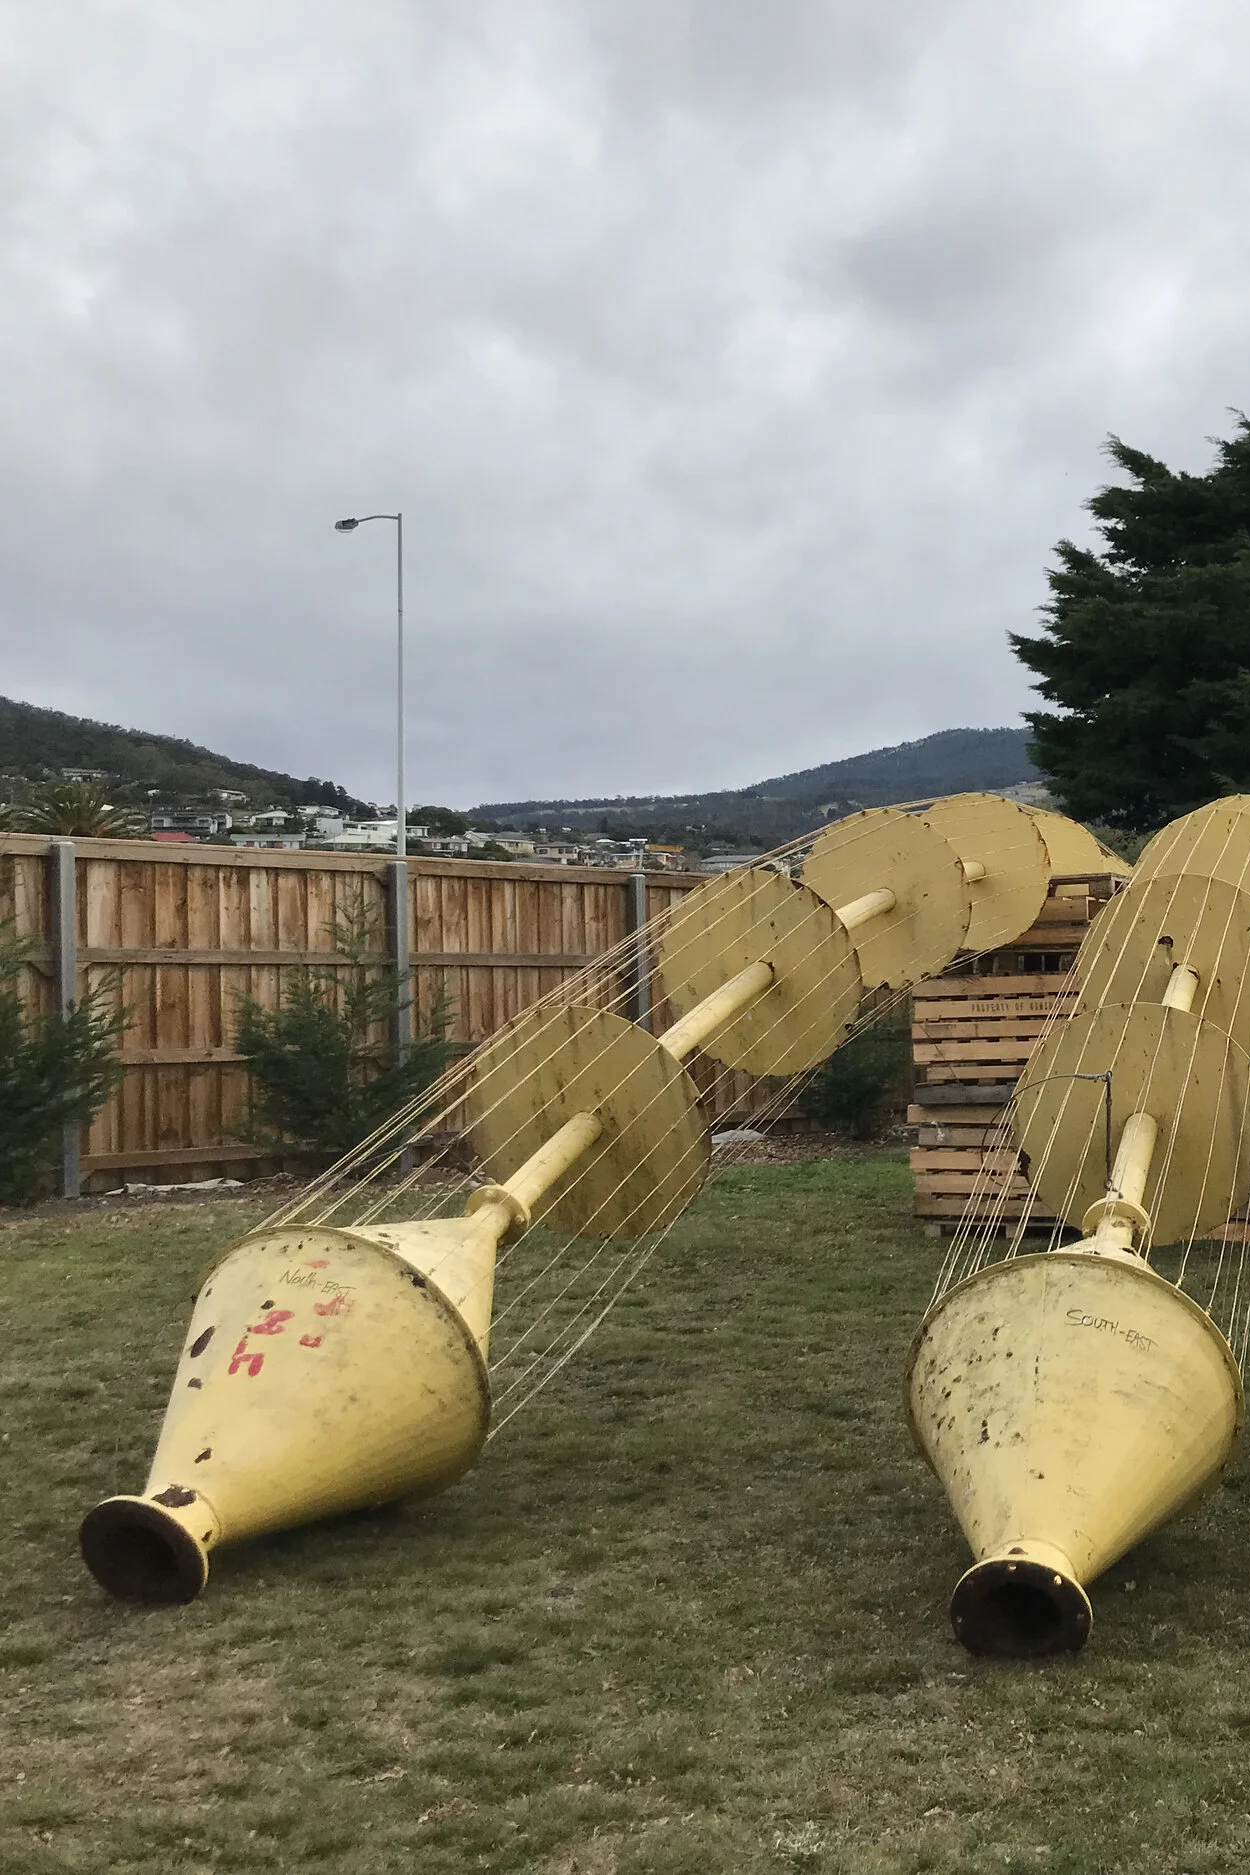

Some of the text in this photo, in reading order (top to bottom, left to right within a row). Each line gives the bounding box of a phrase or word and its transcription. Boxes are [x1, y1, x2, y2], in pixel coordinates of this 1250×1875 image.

[971, 1002, 1009, 1012] PROPERTY
[1015, 1002, 1024, 1011] OF
[1064, 1308, 1159, 1353] SOUTH-EAST
